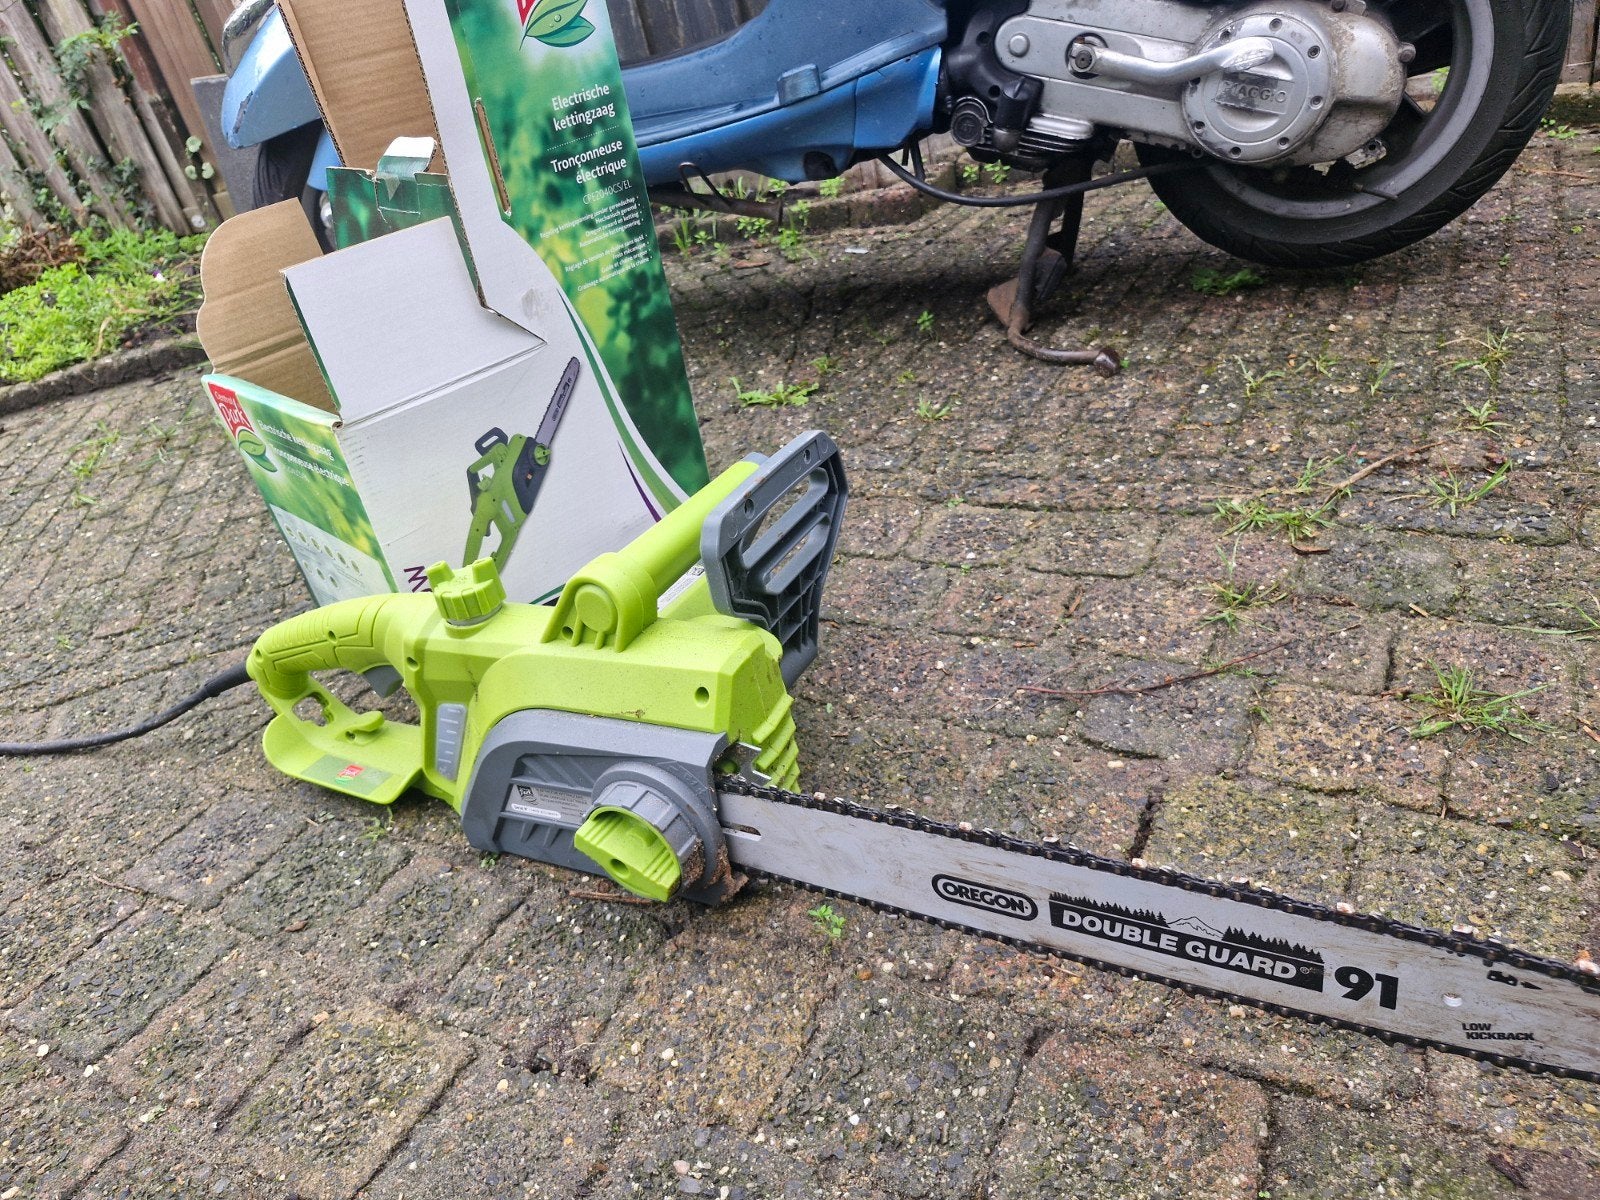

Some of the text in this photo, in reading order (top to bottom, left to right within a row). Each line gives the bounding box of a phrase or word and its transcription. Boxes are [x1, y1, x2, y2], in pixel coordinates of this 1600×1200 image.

[551, 83, 610, 111] Electrische
[553, 102, 616, 131] kettingzaag
[550, 140, 623, 173] Tronçonneuse
[576, 158, 627, 184] électrique
[942, 881, 1026, 914] OREGON
[1062, 909, 1297, 980] DOUBLE GUARD
[1334, 965, 1399, 1011] 91
[1461, 1022, 1492, 1031] LOW
[1465, 1031, 1535, 1041] KICKBACK
